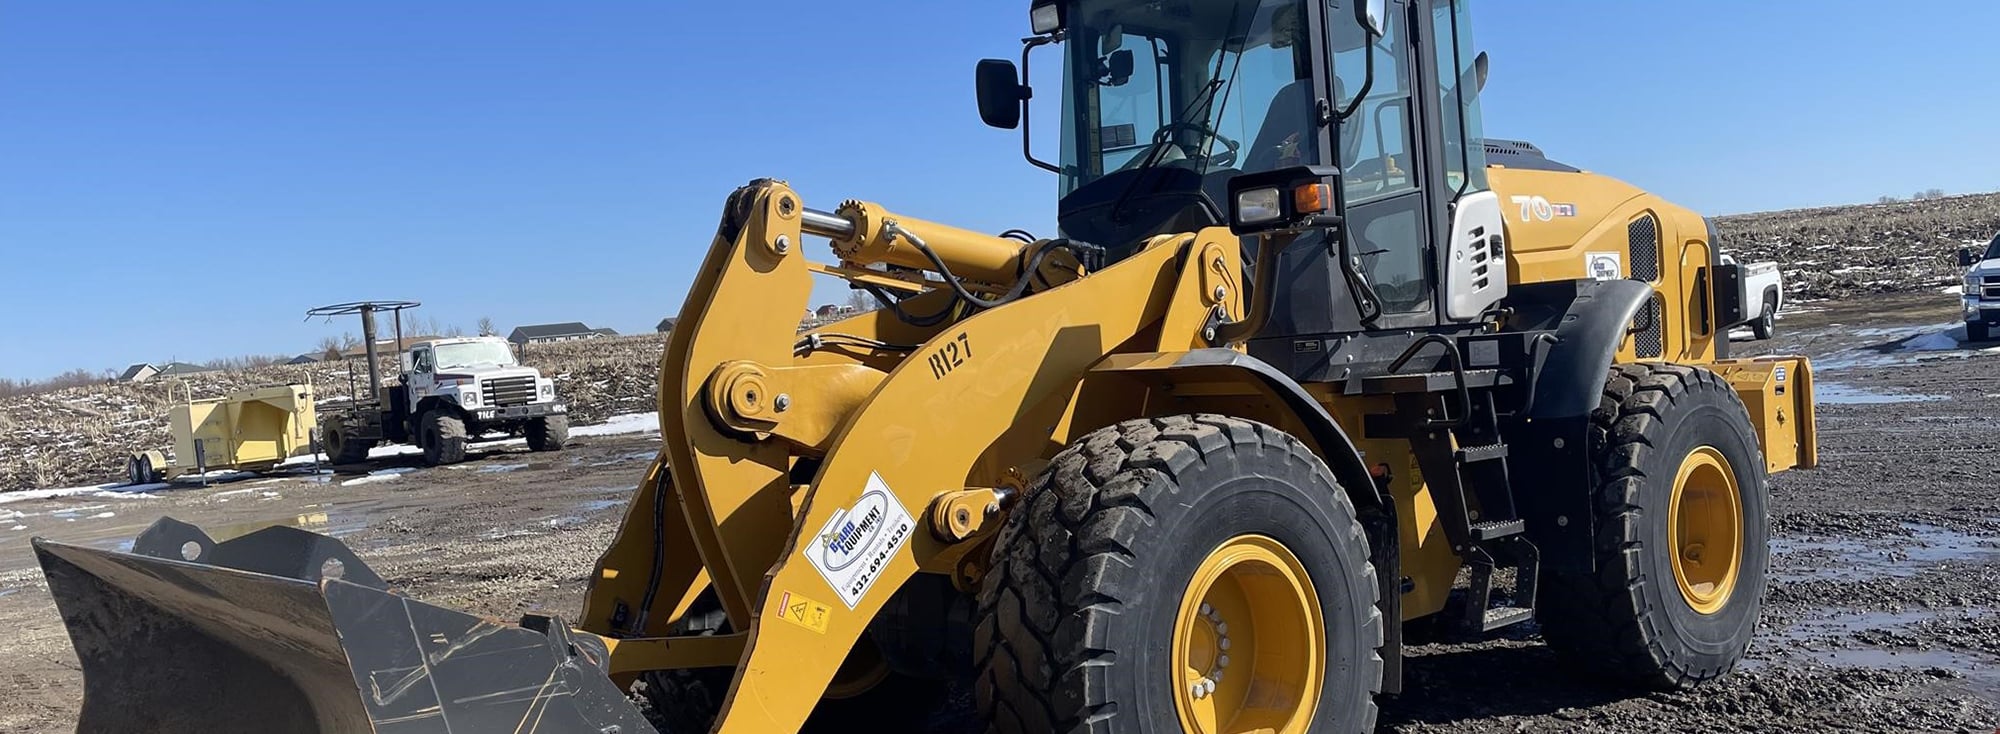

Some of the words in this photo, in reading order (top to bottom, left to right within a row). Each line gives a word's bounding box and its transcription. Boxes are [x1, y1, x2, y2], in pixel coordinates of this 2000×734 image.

[928, 332, 971, 380] R127
[477, 410, 496, 420] TILE
[837, 505, 881, 556] EQUIPMENT
[852, 523, 908, 596] 432-694-4530
